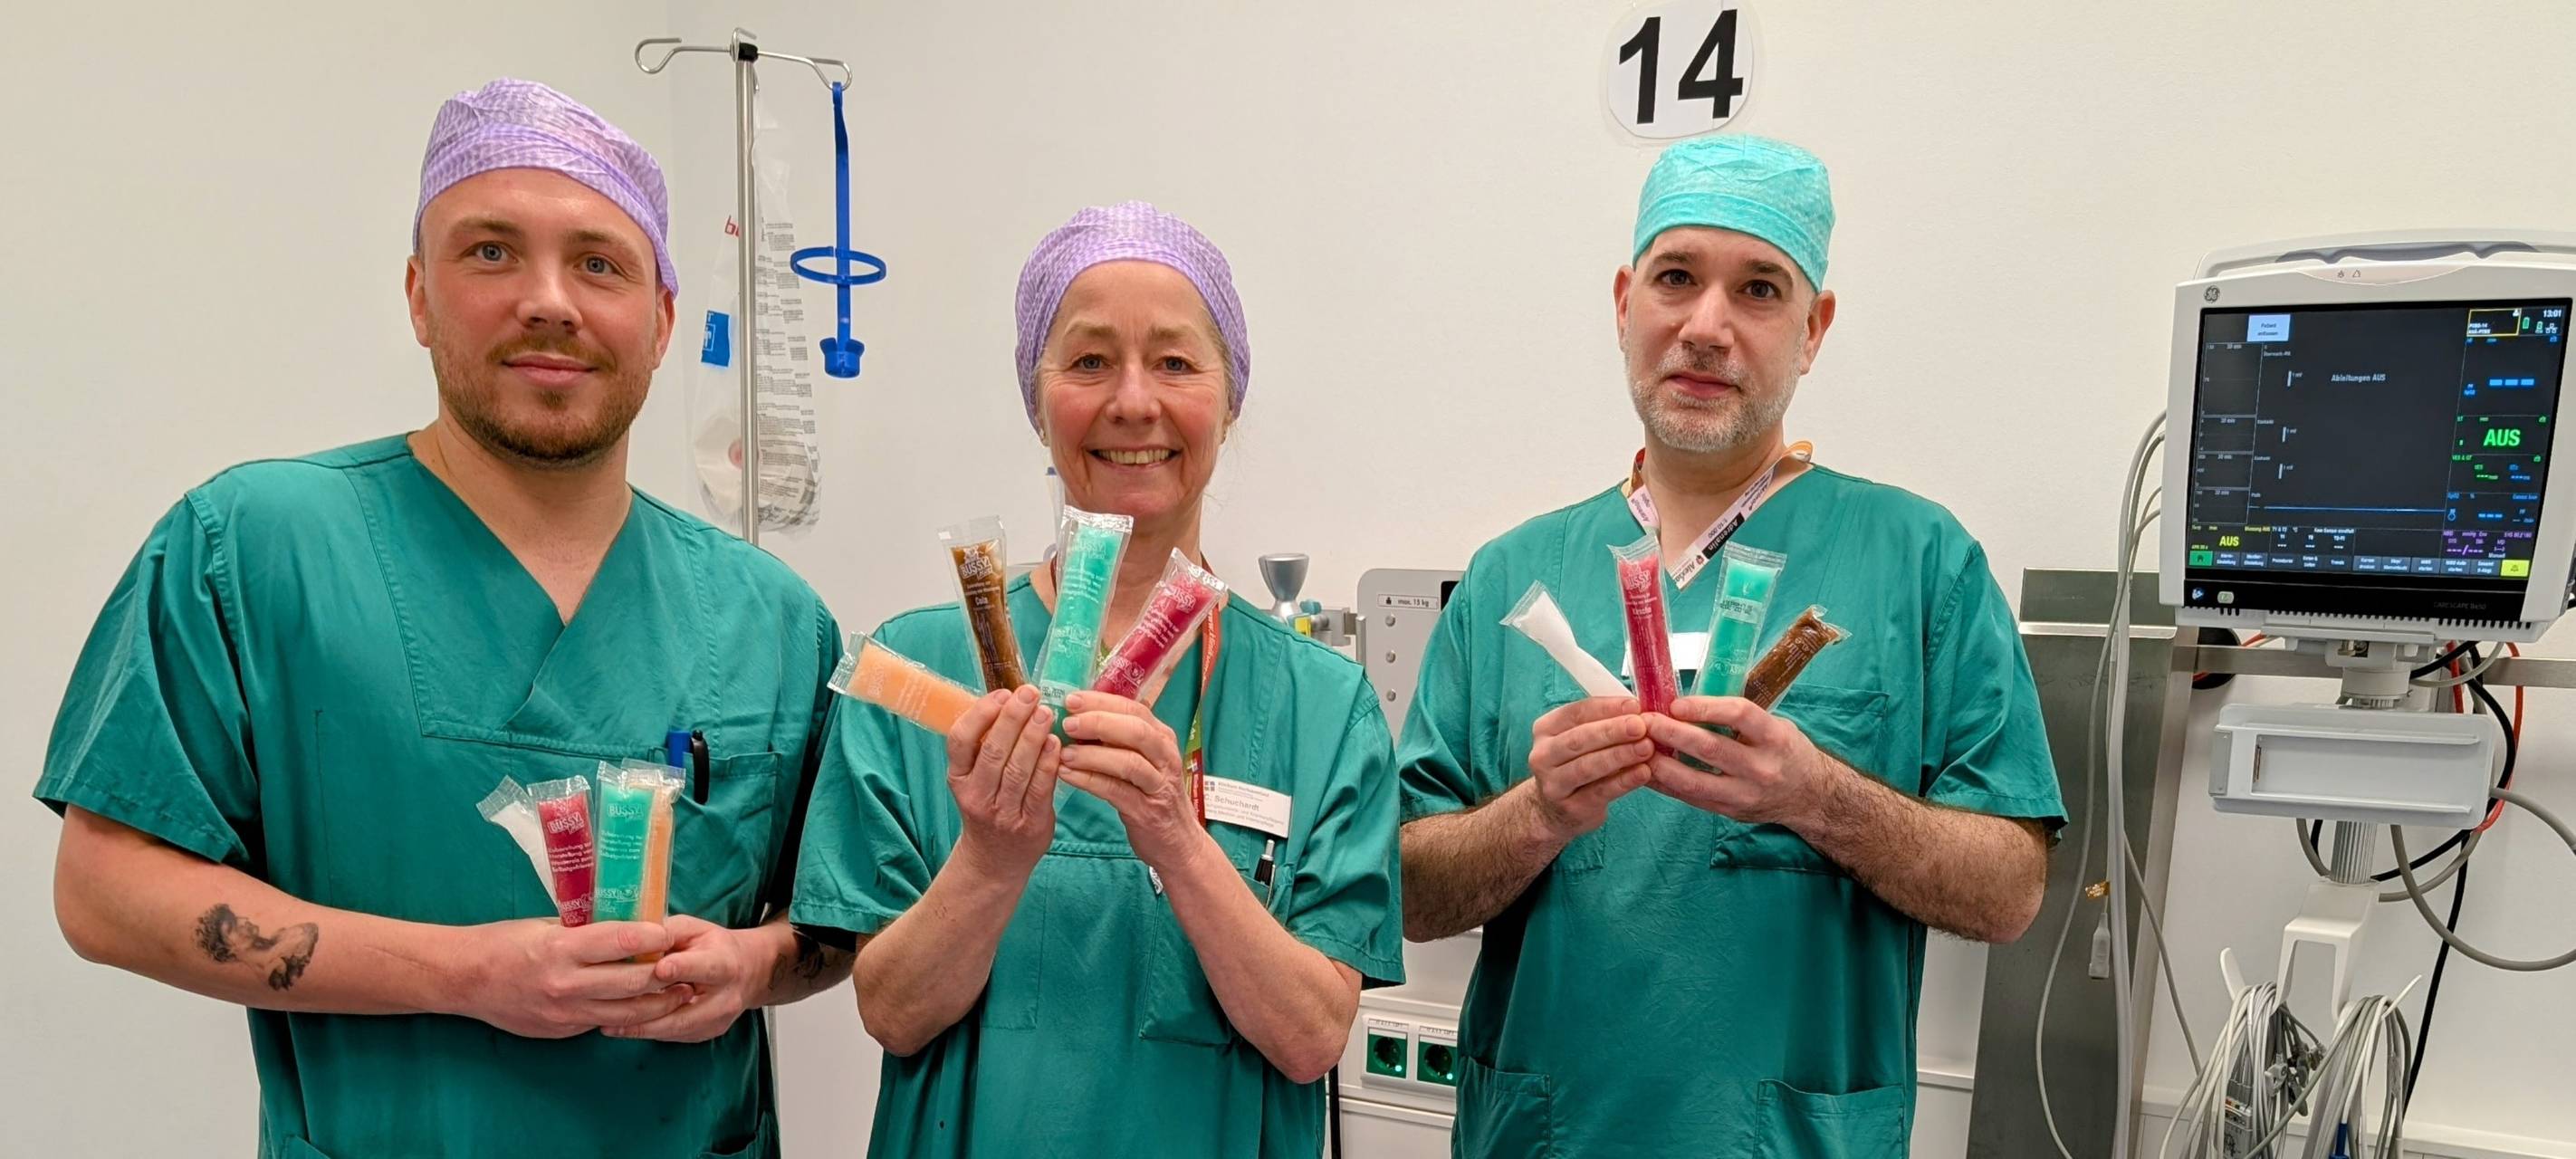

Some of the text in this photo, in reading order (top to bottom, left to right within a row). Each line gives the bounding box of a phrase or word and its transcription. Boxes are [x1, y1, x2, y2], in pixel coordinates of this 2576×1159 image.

[1619, 9, 1743, 124] 14
[2543, 310, 2562, 318] 13:01
[2331, 373, 2386, 384] Ableitungen AUS
[2483, 428, 2521, 446] AUS
[1708, 520, 1738, 551] Adrenalin
[2219, 535, 2239, 547] AUS
[1214, 795, 1259, 811] Schuchardt
